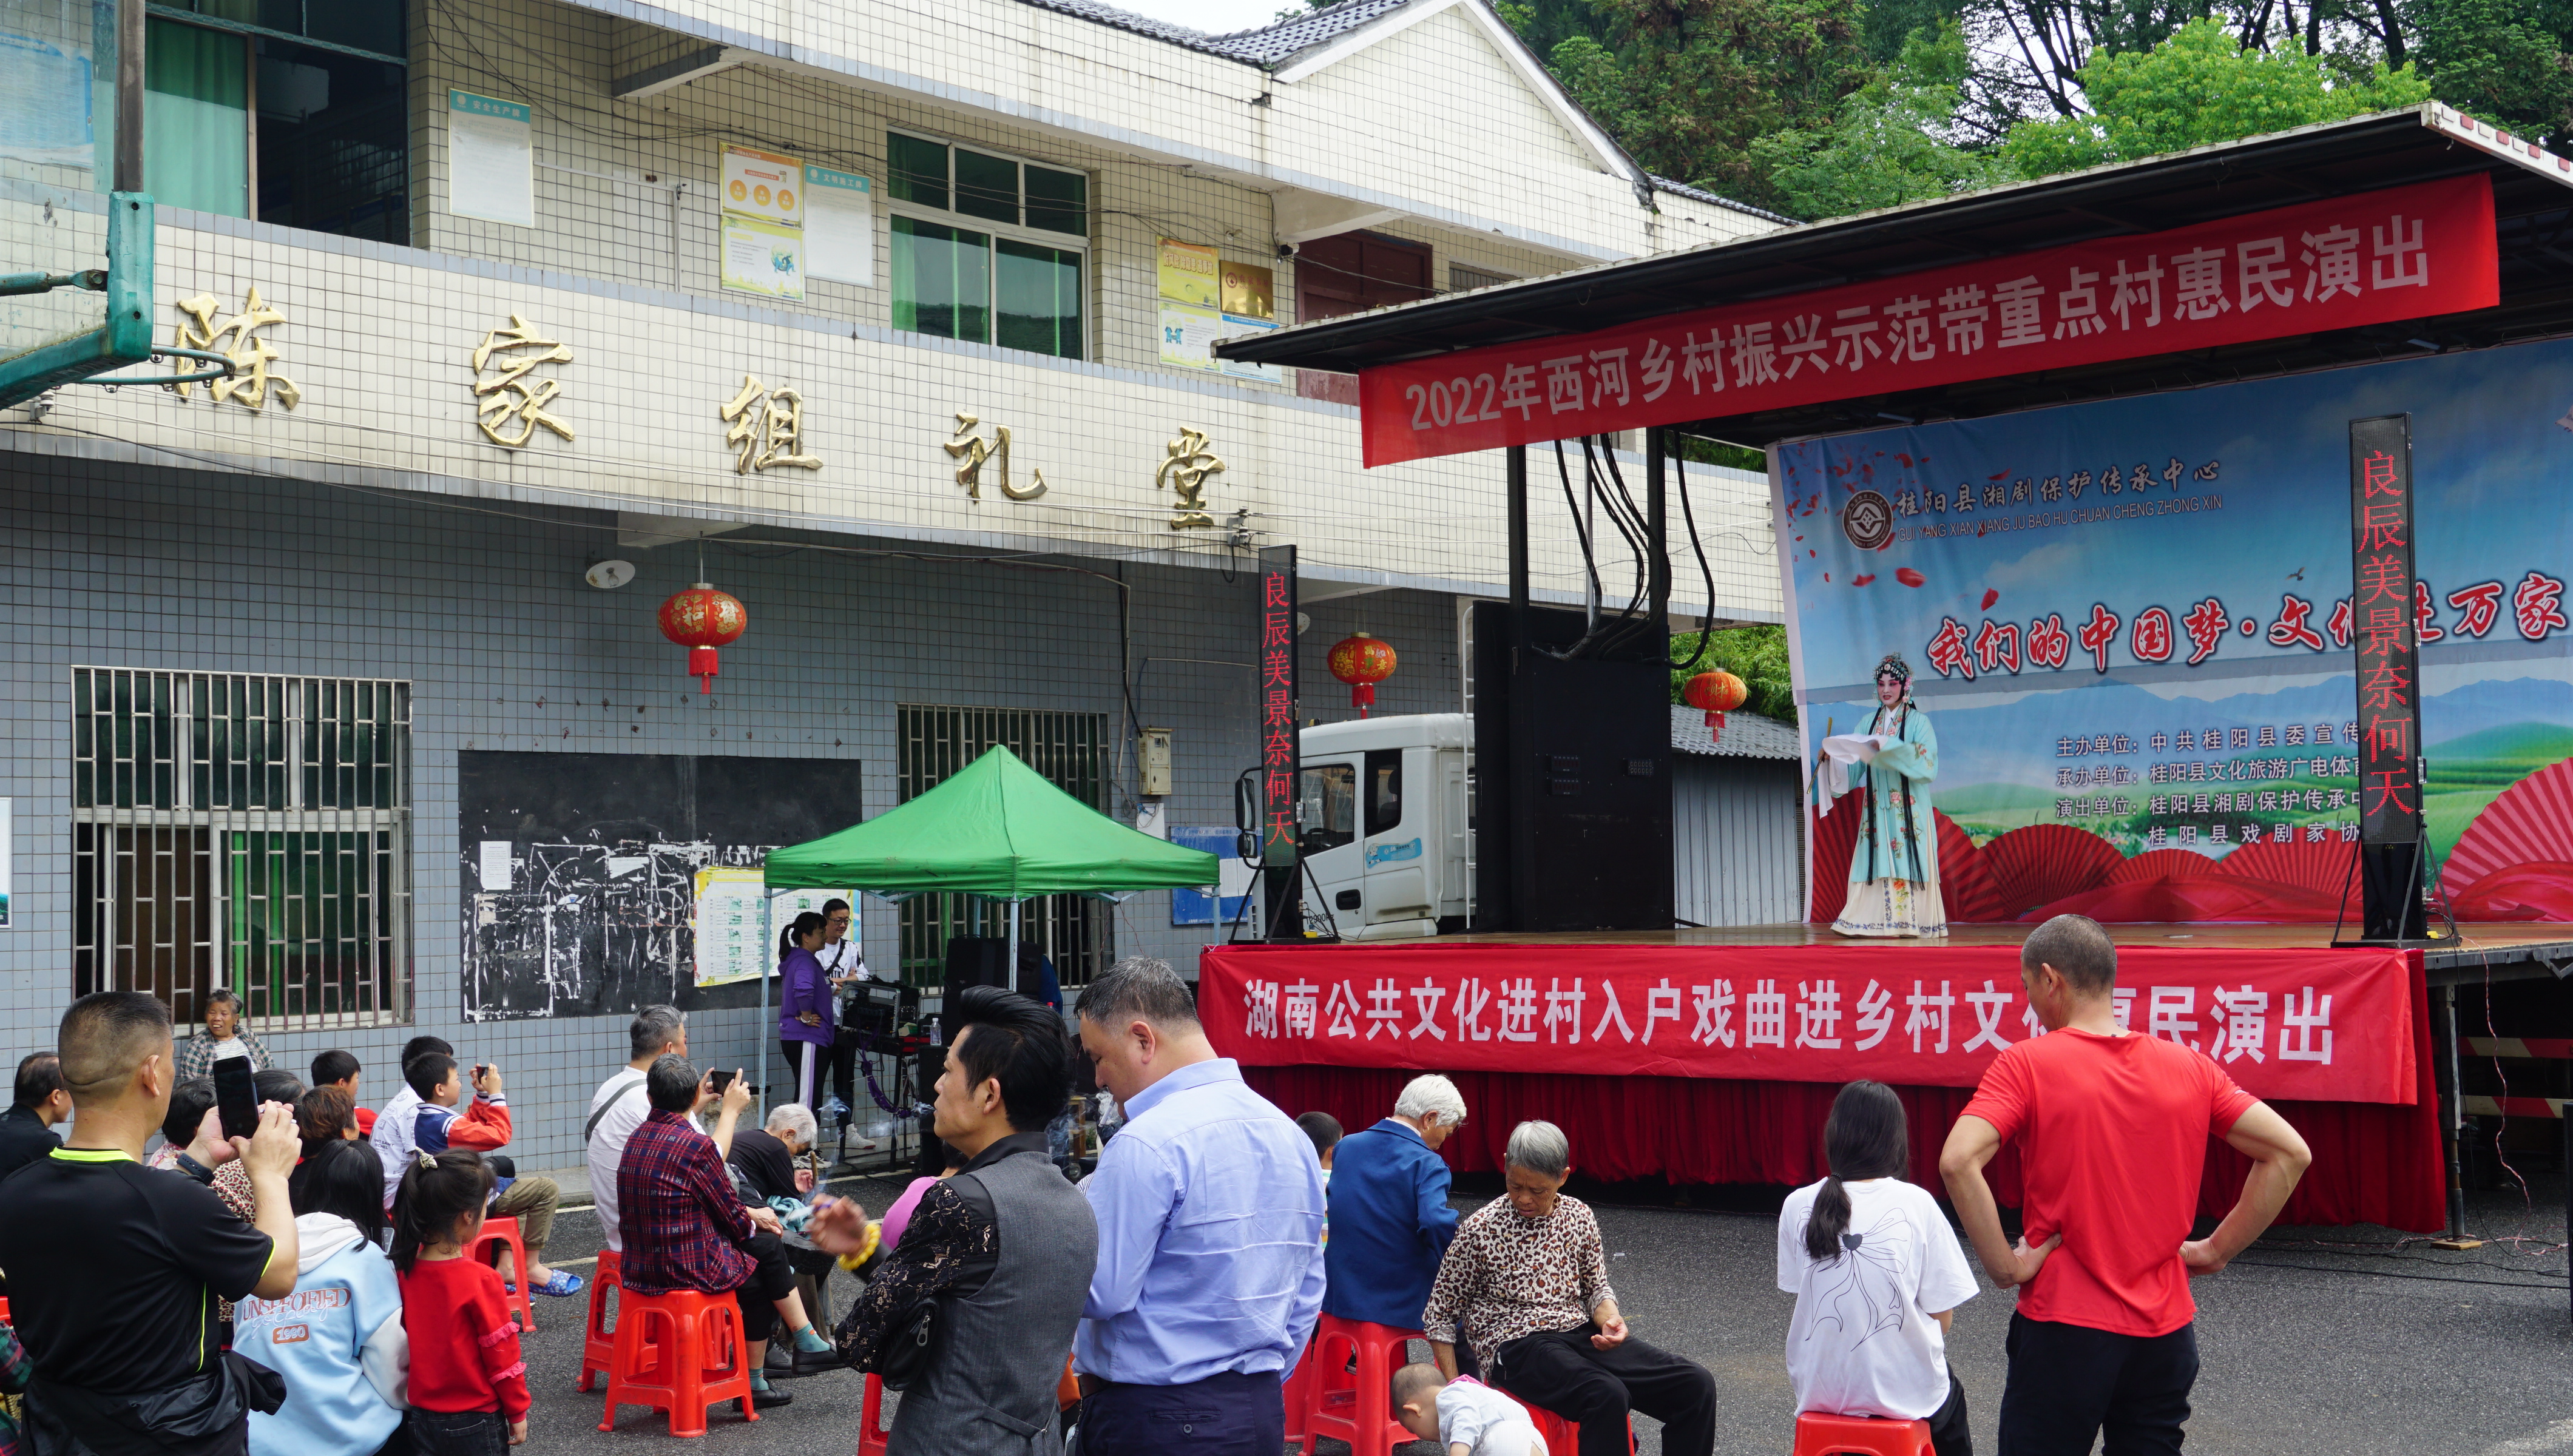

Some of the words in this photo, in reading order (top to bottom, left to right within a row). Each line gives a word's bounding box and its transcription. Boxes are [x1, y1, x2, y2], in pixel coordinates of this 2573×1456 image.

[473, 100, 521, 117] 安全生产牌
[823, 174, 862, 189] 文明施工牌
[1405, 214, 2429, 430] 2022年西河乡村振兴示范带重点村惠民演出
[1896, 458, 2219, 519] 桂阳县湘剧保护传承中心
[1898, 528, 1915, 542] GUI
[1918, 524, 1946, 538] YANG
[1950, 521, 1973, 536] XIAN
[1977, 517, 2009, 534] XIANG
[2013, 516, 2025, 530] JU
[2029, 513, 2050, 528] BAO
[2053, 511, 2068, 525] HU
[2071, 507, 2110, 523] CHUAN
[2114, 502, 2154, 519] CHENG
[2158, 497, 2199, 515] ZHONG
[2202, 495, 2222, 510] XIN
[2357, 451, 2413, 817] 良辰美景奈何天
[1263, 571, 1294, 847] 良辰美景奈何天
[276, 1326, 306, 1341] 1990
